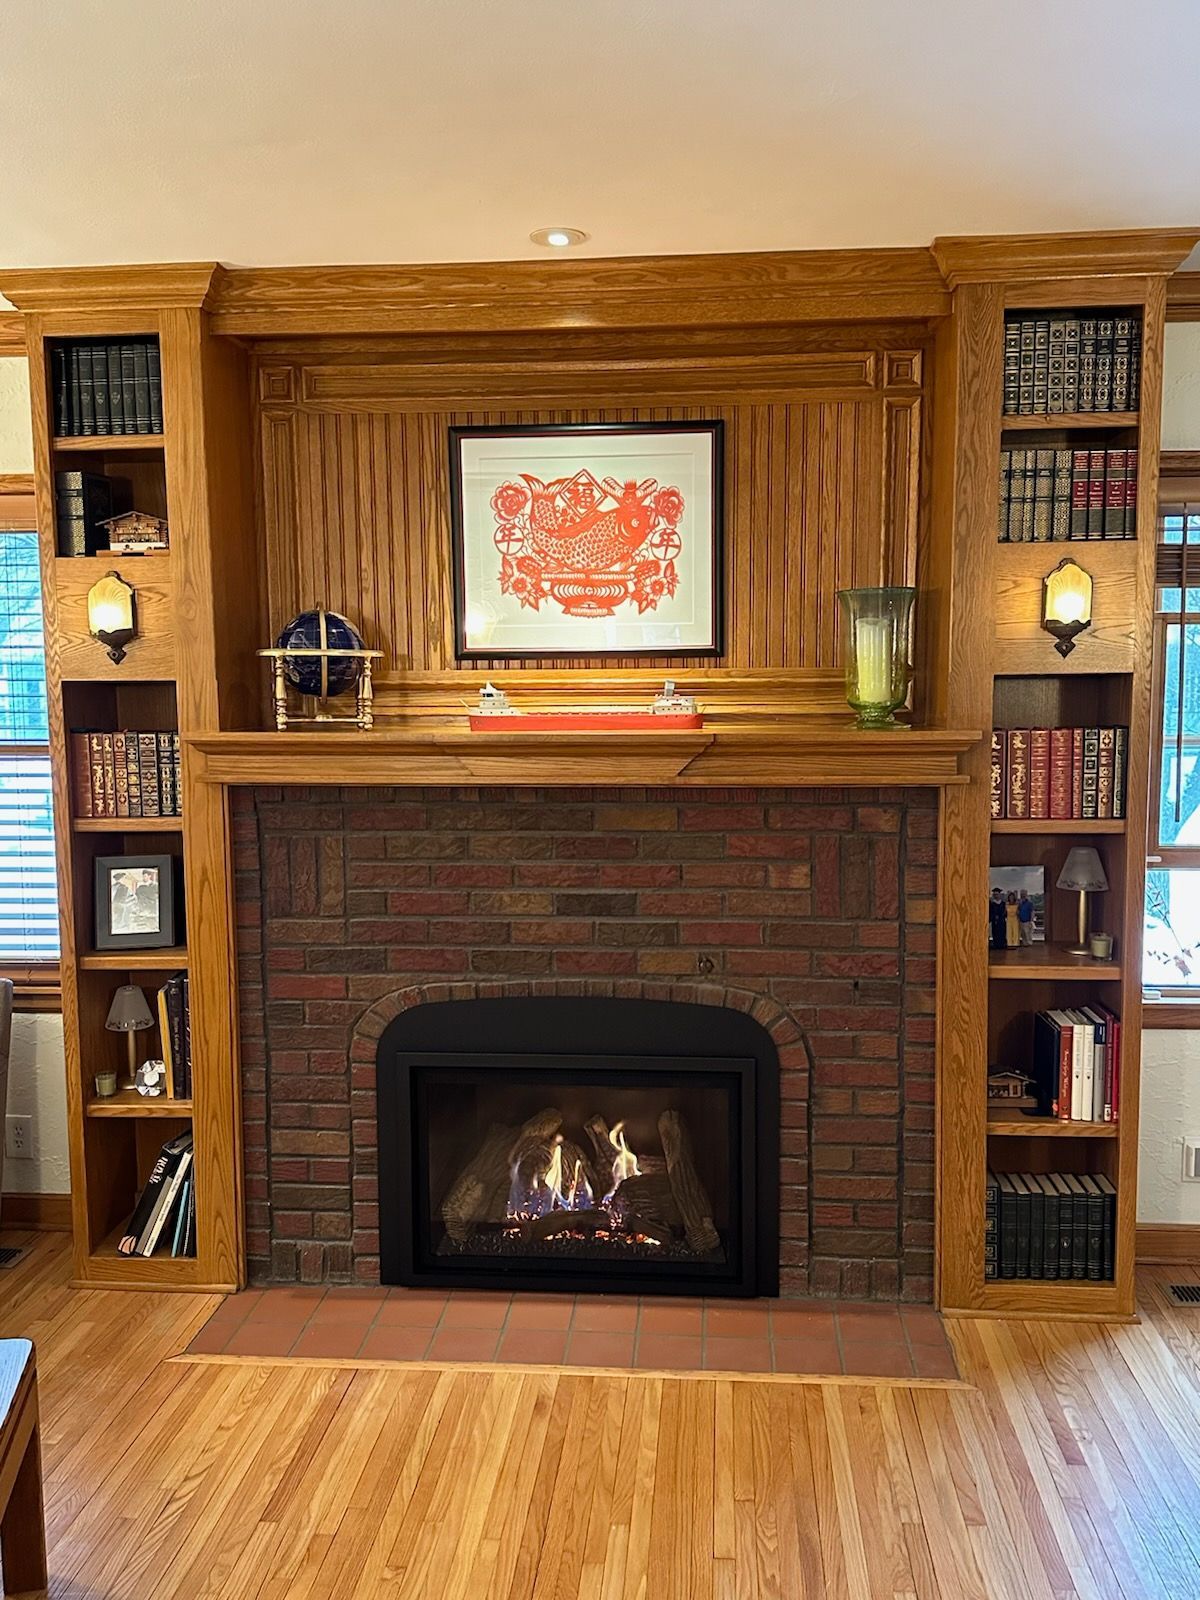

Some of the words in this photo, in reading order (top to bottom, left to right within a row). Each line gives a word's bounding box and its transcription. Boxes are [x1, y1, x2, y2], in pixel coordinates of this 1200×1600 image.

[568, 481, 596, 509] 福
[496, 523, 524, 553] 年
[651, 528, 680, 560] 年
